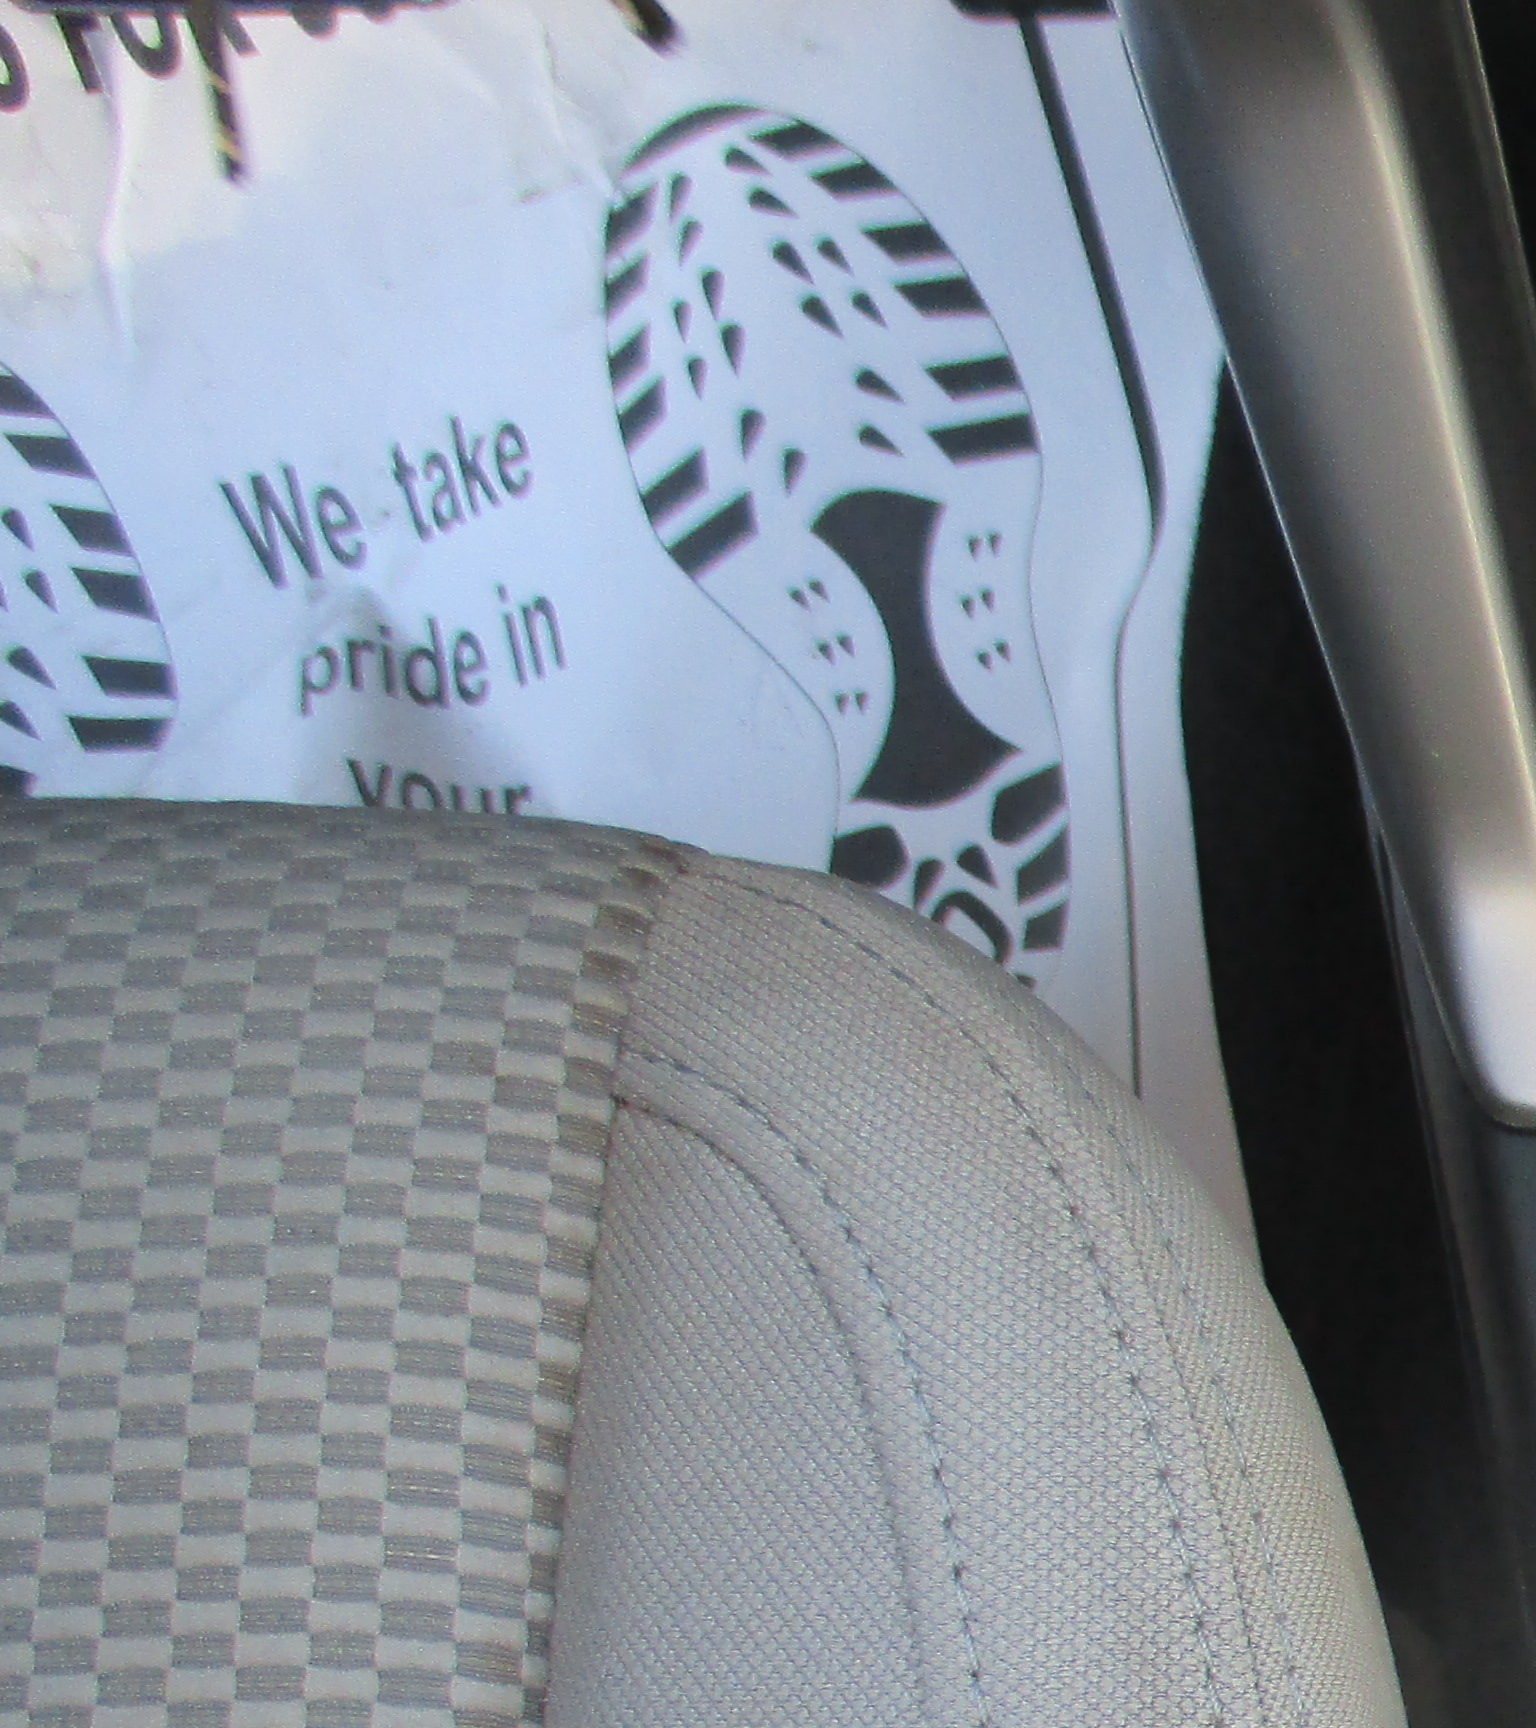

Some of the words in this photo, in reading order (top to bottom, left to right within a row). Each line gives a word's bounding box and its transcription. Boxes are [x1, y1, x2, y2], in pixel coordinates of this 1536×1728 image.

[219, 462, 369, 590] We
[391, 414, 535, 542] take
[299, 615, 491, 717] pride
[496, 583, 568, 687] in
